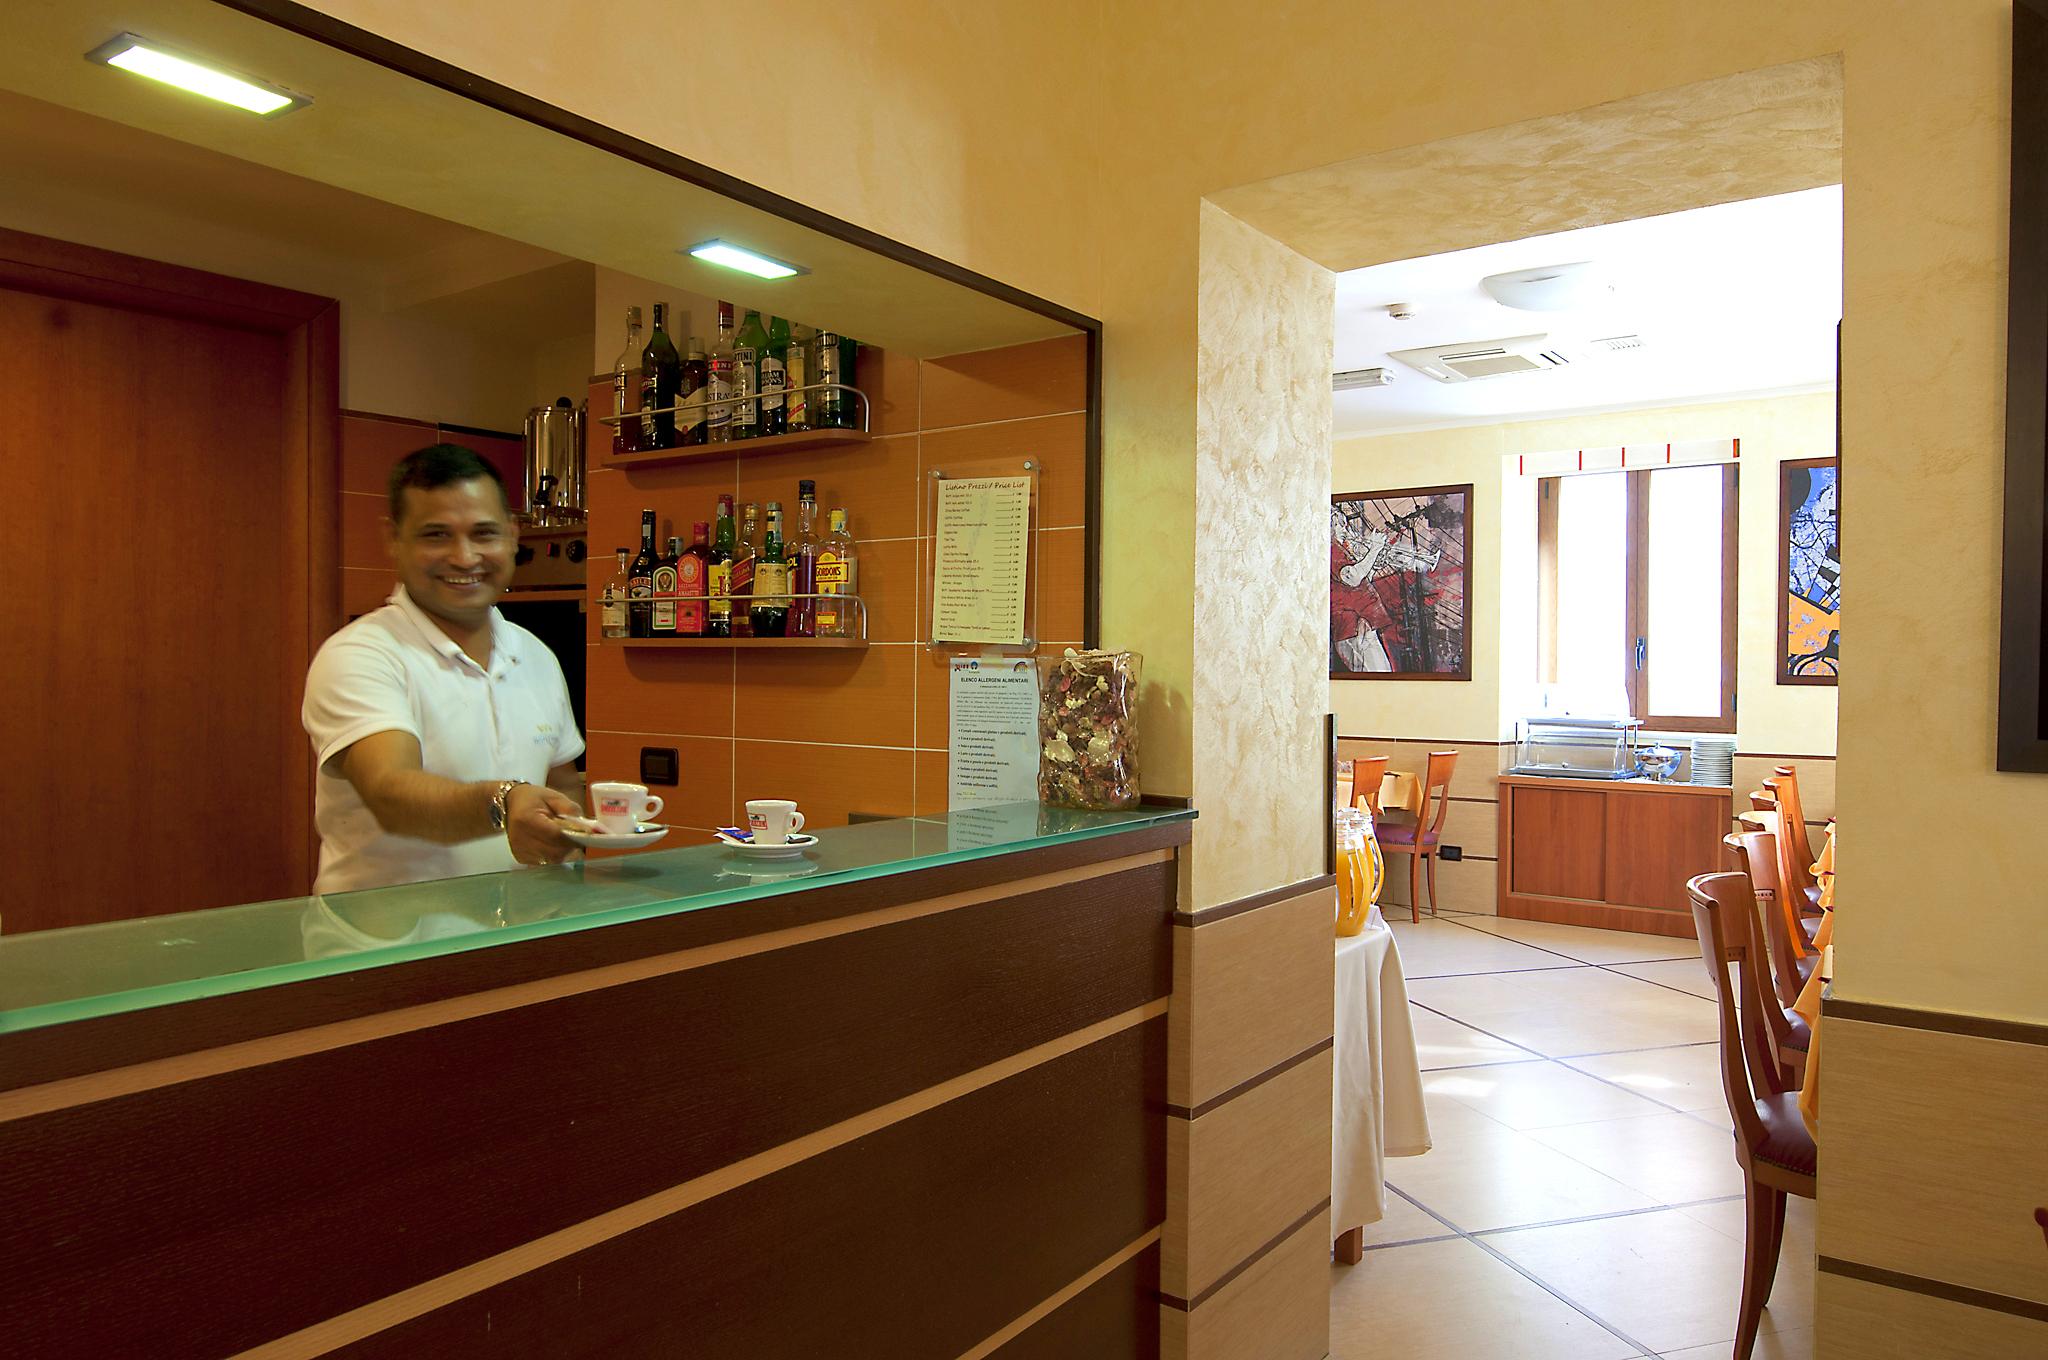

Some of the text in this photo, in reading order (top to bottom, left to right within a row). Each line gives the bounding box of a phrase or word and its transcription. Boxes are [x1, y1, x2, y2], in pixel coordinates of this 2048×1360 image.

[945, 482, 966, 491] Listino
[968, 482, 988, 490] Prezzi
[1012, 481, 1025, 489] List
[787, 557, 799, 567] OL
[816, 566, 842, 577] GORDON'S
